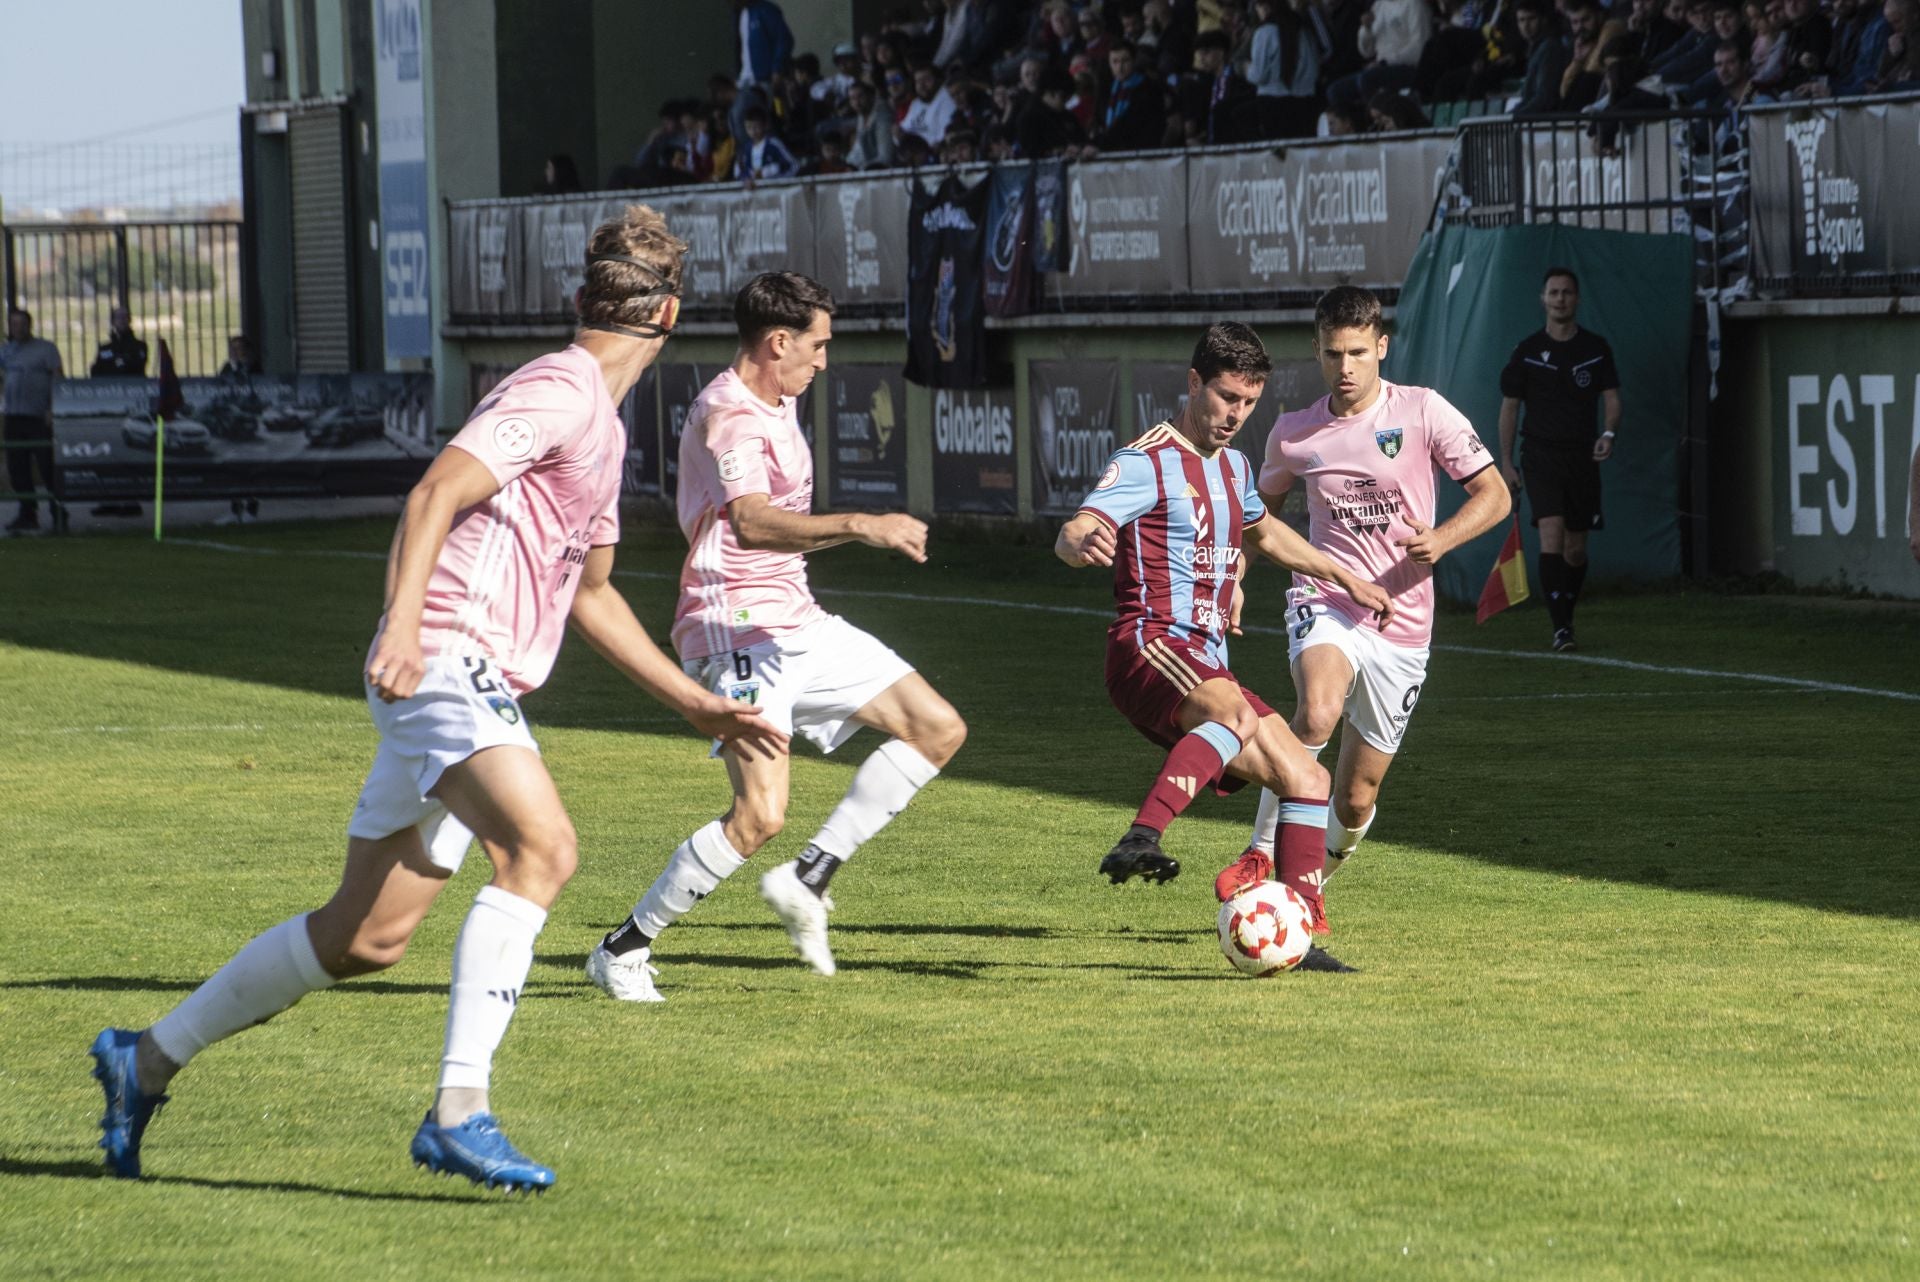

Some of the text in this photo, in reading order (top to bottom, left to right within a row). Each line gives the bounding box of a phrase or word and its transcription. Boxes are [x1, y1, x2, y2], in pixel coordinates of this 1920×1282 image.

[1217, 163, 1288, 255] cajaviva
[1306, 150, 1387, 240] cajarural
[1250, 239, 1289, 281] Segovia
[1308, 232, 1365, 272] Fundación
[1818, 206, 1864, 264] Segovia
[935, 388, 1012, 455] Globales
[1326, 488, 1402, 507] AUTONERVION
